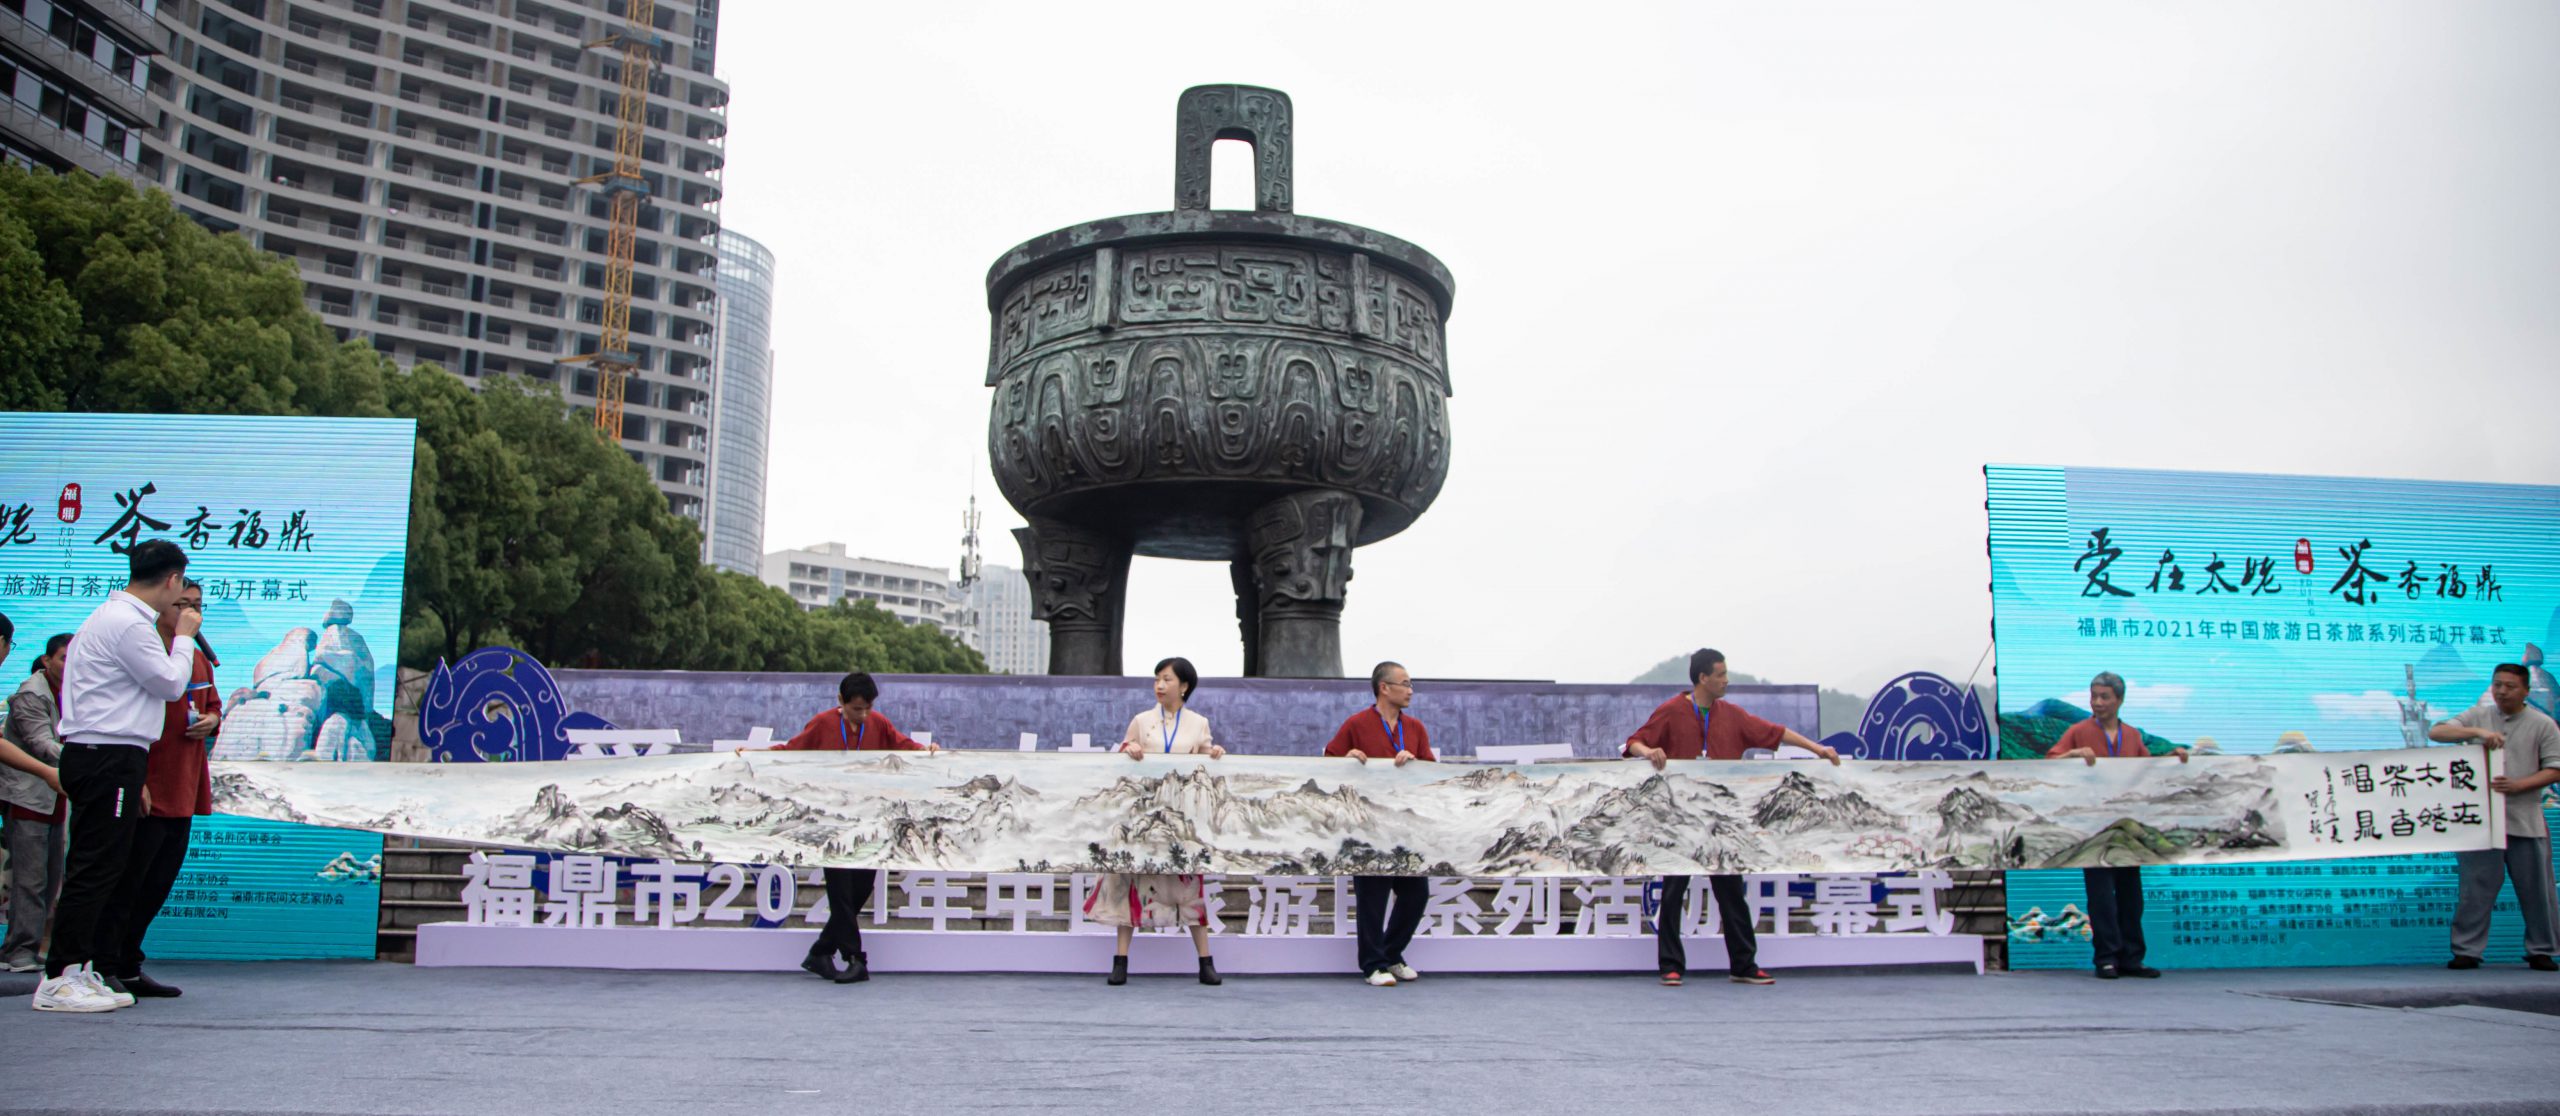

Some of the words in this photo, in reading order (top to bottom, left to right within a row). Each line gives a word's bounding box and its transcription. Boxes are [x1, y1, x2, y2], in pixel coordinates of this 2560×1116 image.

[2328, 538, 2502, 606] 茶香福鼎
[2077, 616, 2507, 647] 福鼎市2021年中国旅游日茶旅系列活动开幕式
